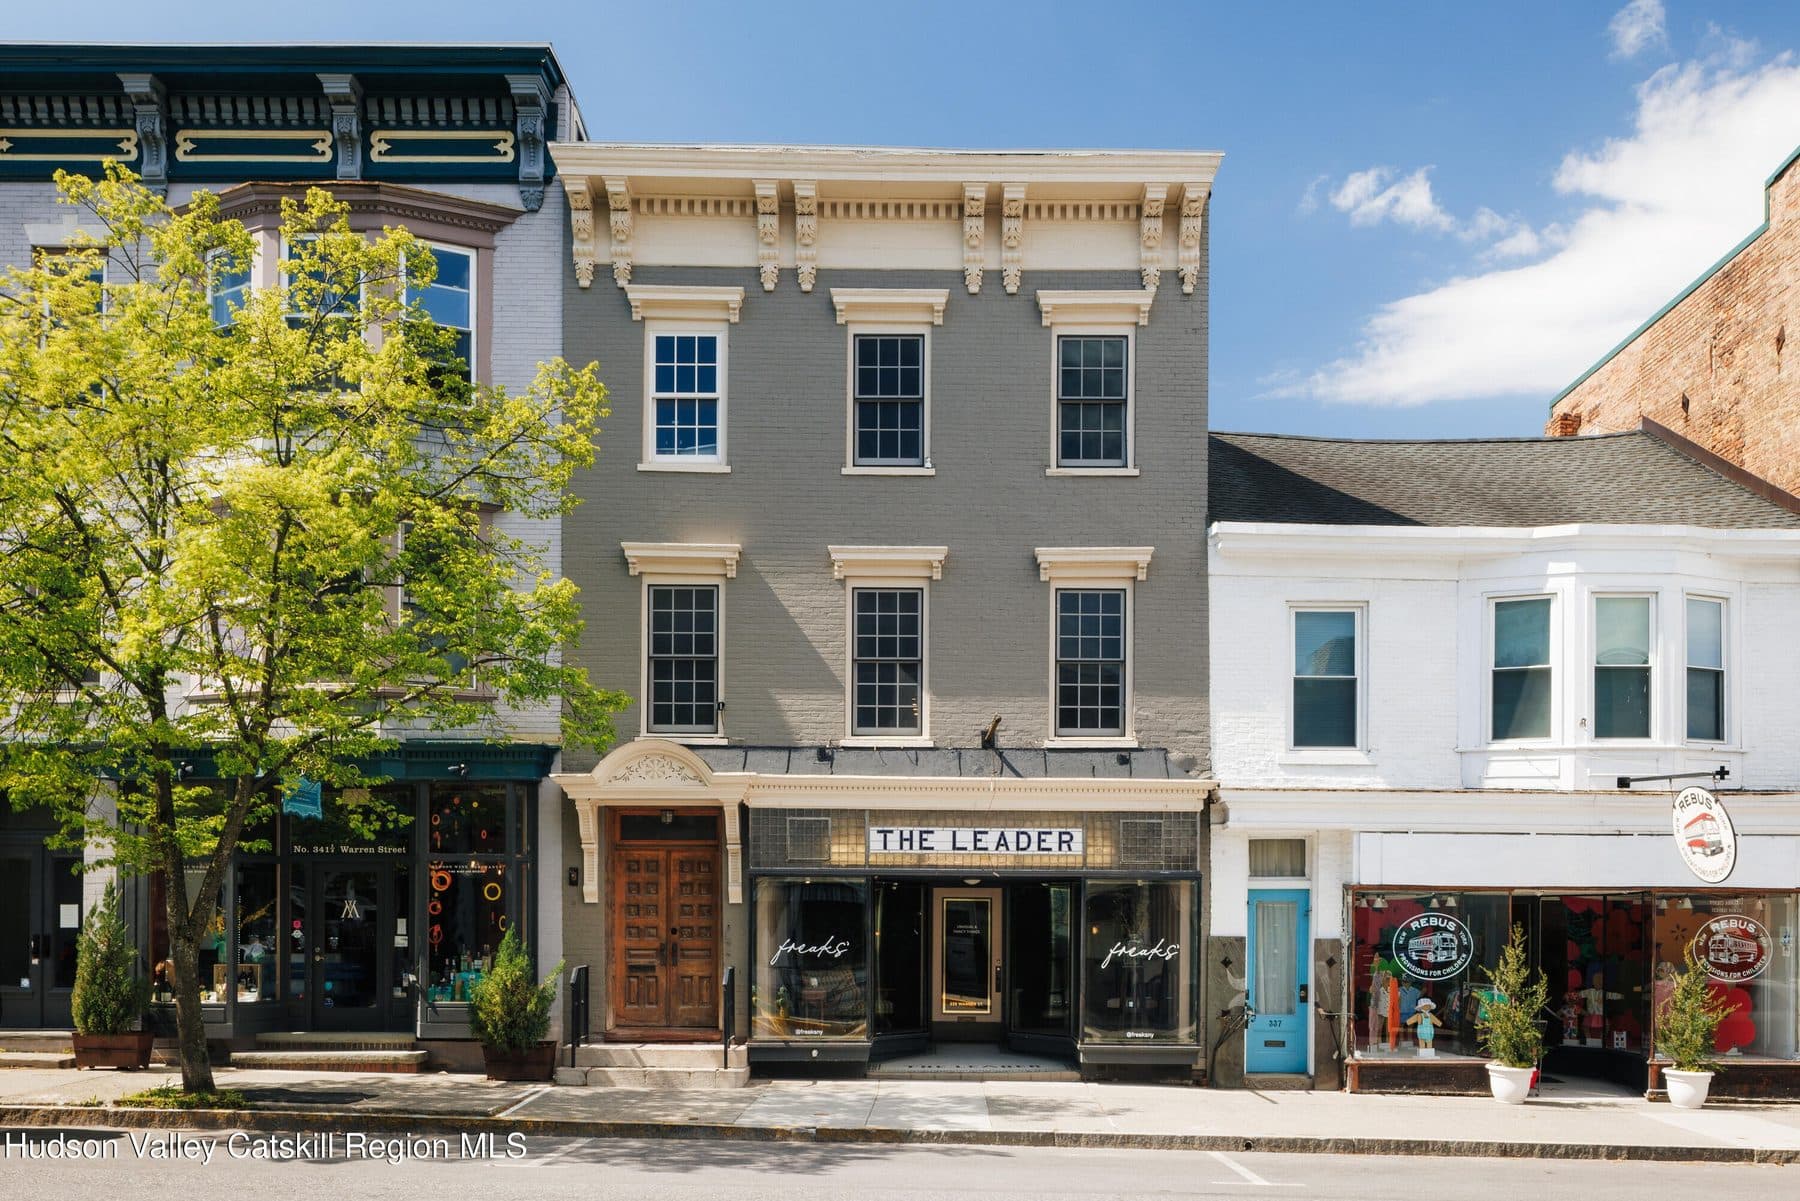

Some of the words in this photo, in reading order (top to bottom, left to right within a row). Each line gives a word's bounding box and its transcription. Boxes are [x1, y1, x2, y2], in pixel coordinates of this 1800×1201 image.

[1678, 793, 1713, 814] REBUS
[877, 830, 935, 851] THE
[952, 830, 1074, 852] LEADER
[294, 845, 310, 853] No.
[340, 845, 375, 854] Warren
[378, 845, 406, 854] Street
[1410, 916, 1457, 932] REBUS
[1709, 919, 1757, 933] REBUS
[1398, 931, 1407, 945] NEW
[1459, 930, 1468, 946] YORK
[1399, 952, 1429, 976] PROVISIONS
